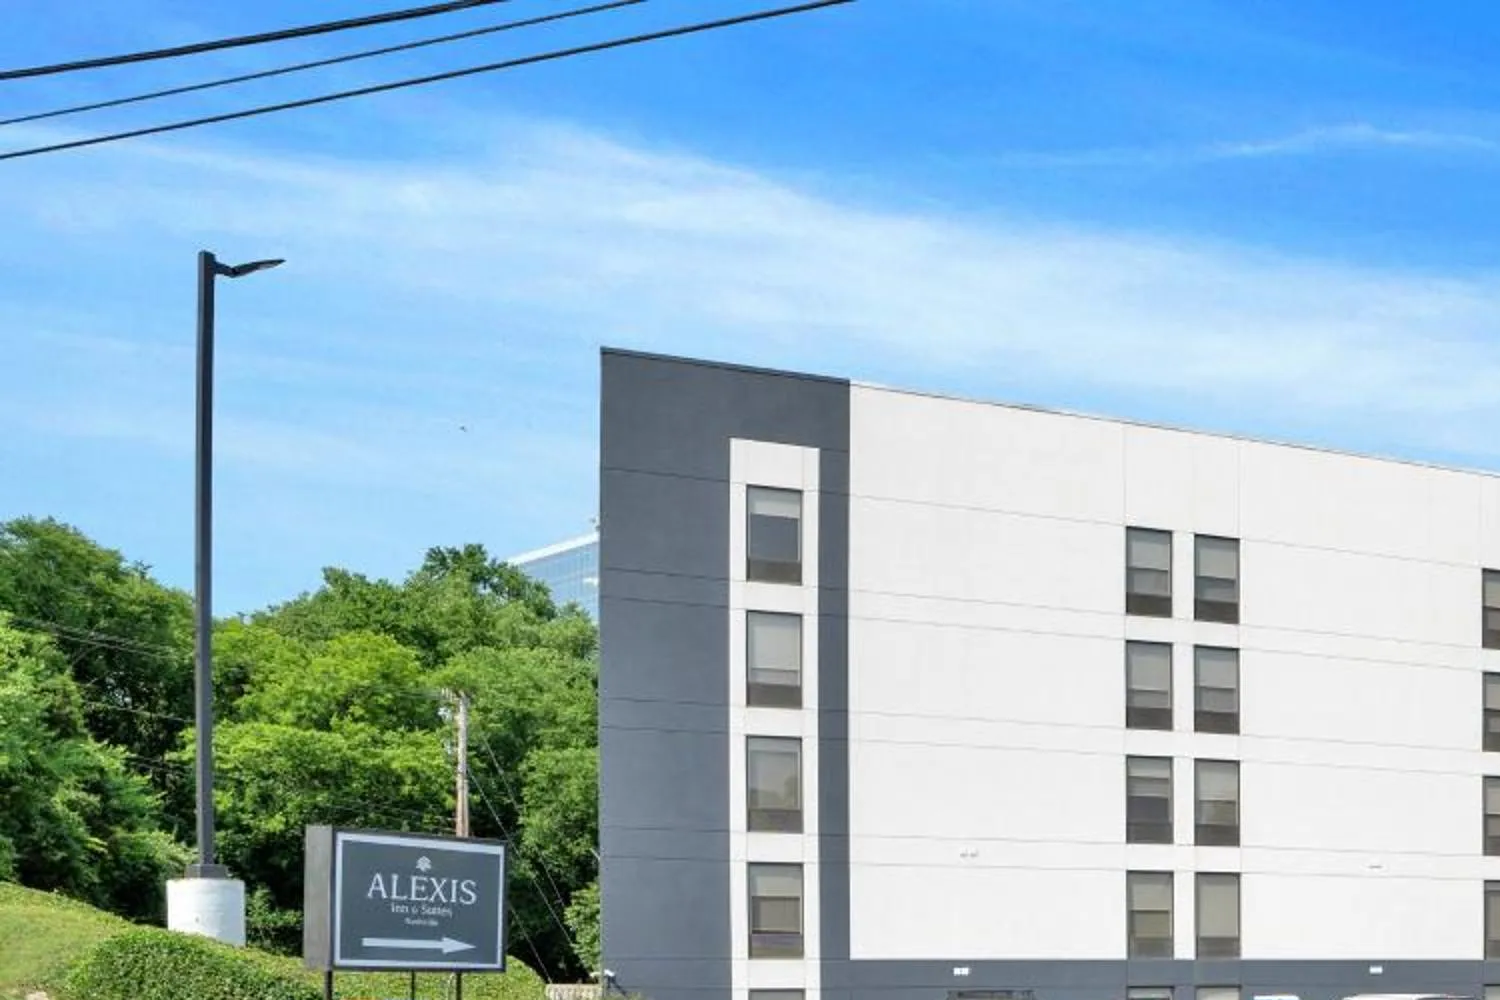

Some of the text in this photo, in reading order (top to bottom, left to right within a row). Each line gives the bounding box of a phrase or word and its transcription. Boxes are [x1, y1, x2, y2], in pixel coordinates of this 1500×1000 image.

[367, 872, 478, 905] ALEXIS
[391, 902, 409, 913] Inn
[421, 904, 453, 917] Suites
